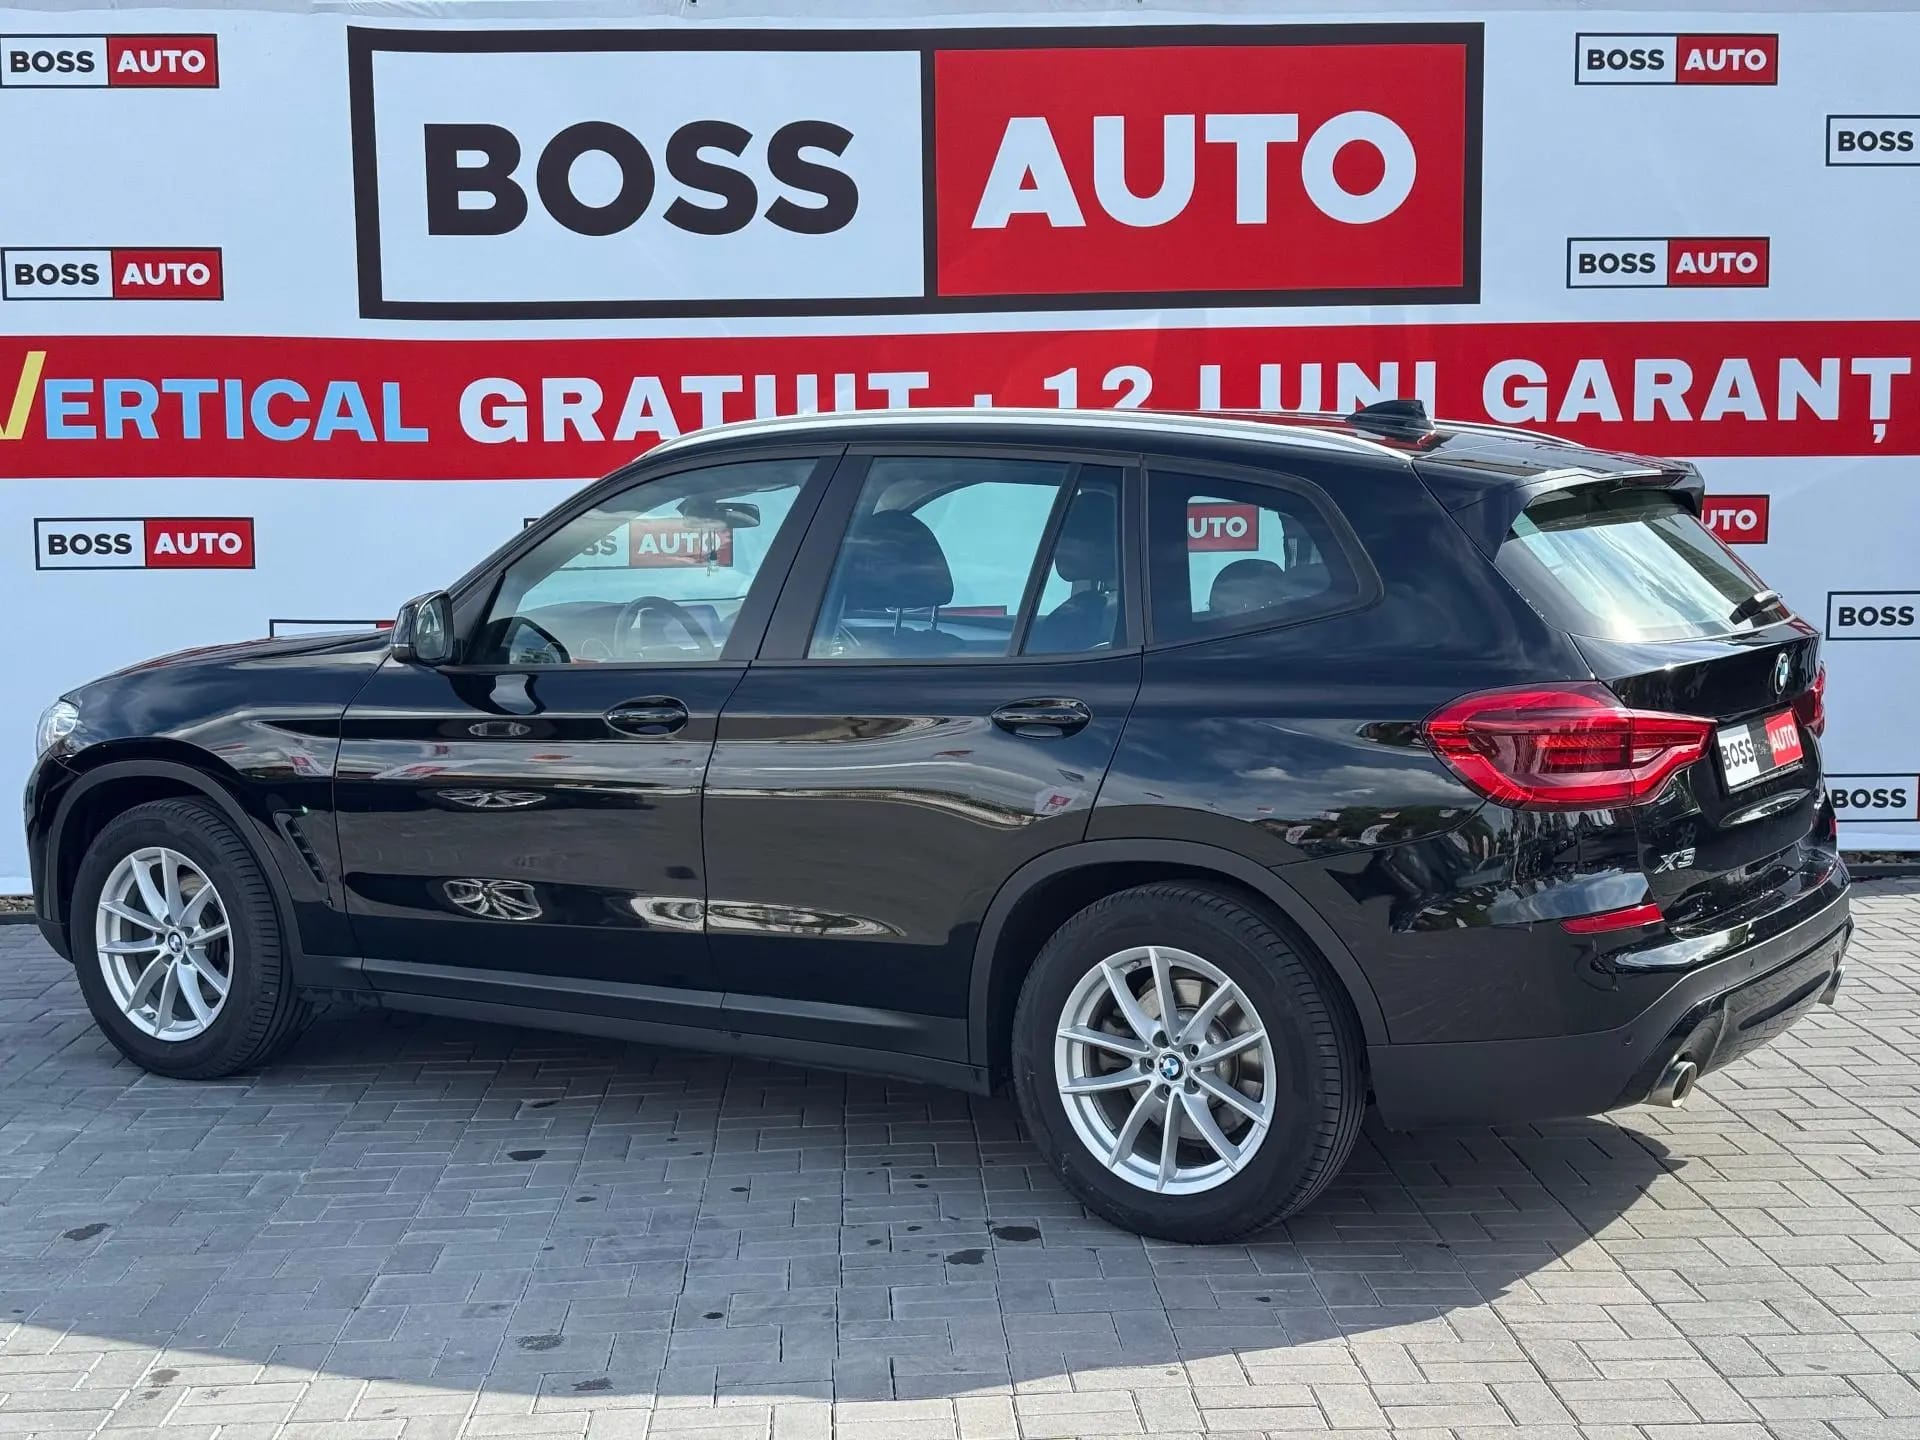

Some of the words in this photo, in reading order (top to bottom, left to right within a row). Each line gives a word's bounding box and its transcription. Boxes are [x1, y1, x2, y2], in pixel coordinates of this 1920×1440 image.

[9, 50, 95, 73] BOSS
[117, 50, 206, 73] AUTO
[1586, 49, 1665, 71] BOSS
[1684, 48, 1767, 71] AUTO
[1837, 130, 1914, 152] BOSS
[423, 119, 859, 237] BOSS
[971, 110, 1417, 229] AUTO
[14, 263, 100, 286] BOSS
[121, 262, 211, 286] AUTO
[1578, 252, 1656, 274] BOSS
[1675, 251, 1758, 274] AUTO
[459, 371, 930, 444] GRATUIT
[1187, 516, 1248, 539] UTO
[1701, 508, 1758, 531] UTO
[47, 533, 133, 556] BOSS
[154, 532, 243, 555] AUTO
[637, 532, 721, 555] AUTO
[1838, 605, 1915, 627] BOSS
[1720, 738, 1755, 771] BOSS
[1770, 723, 1797, 752] AUTO
[1831, 788, 1908, 809] BOSS
[1653, 847, 1696, 875] X3
